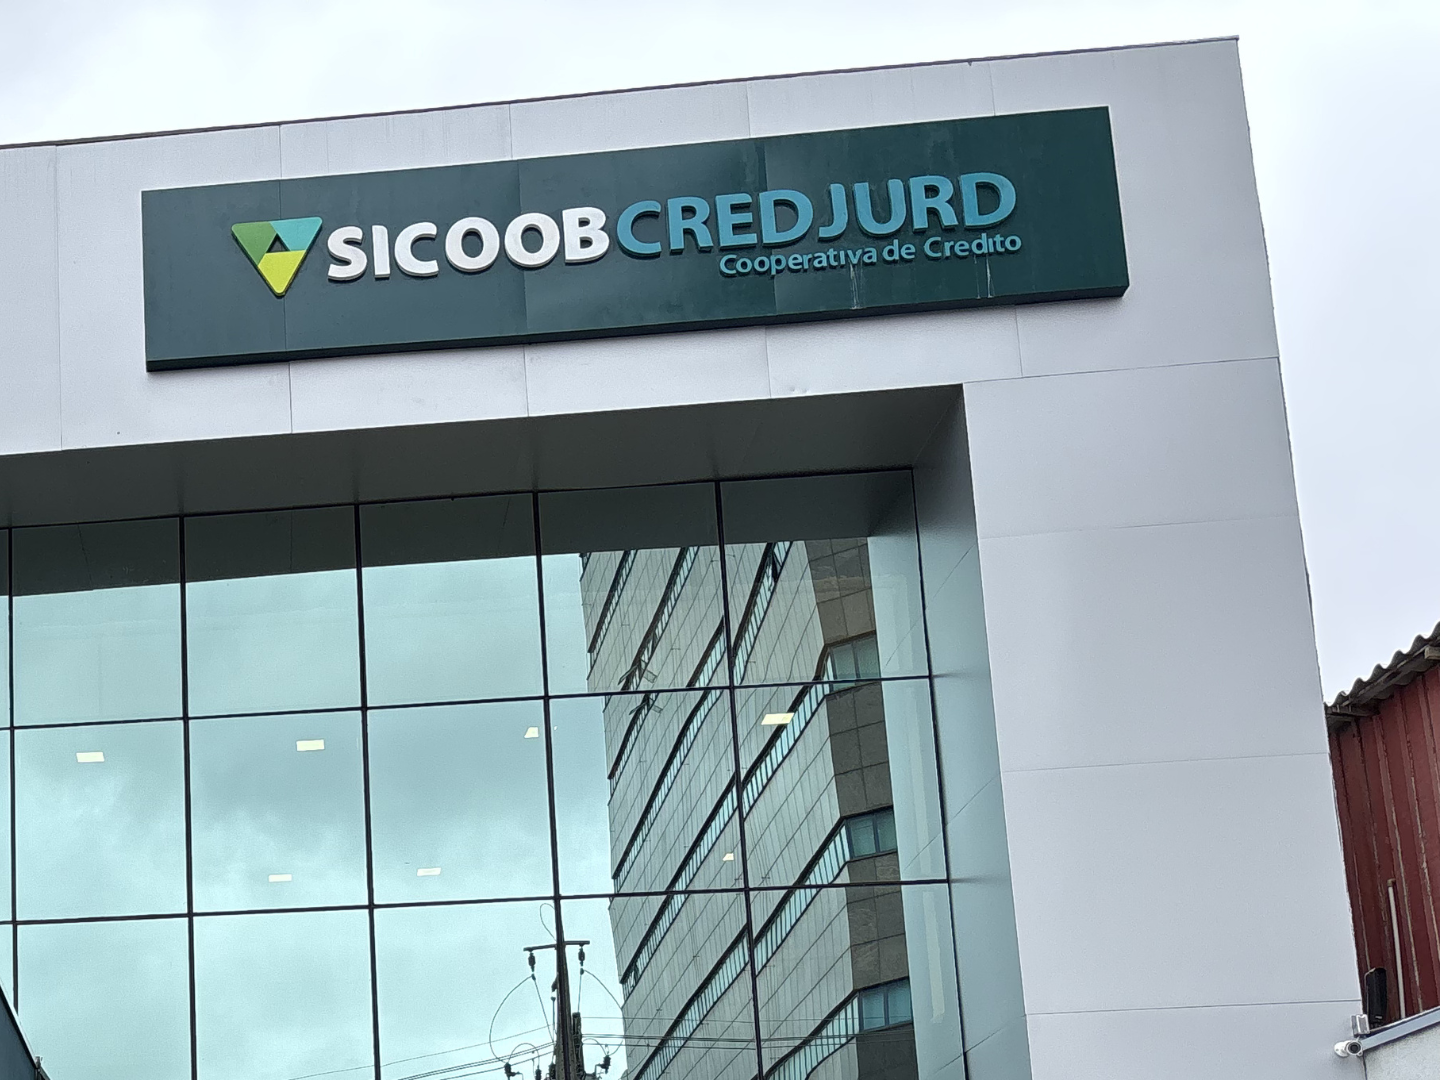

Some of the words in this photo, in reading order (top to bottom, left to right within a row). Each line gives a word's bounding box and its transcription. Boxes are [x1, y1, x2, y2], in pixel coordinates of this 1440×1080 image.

[327, 206, 610, 282] SICOOB
[719, 248, 878, 277] Cooperativa
[882, 237, 917, 262] de
